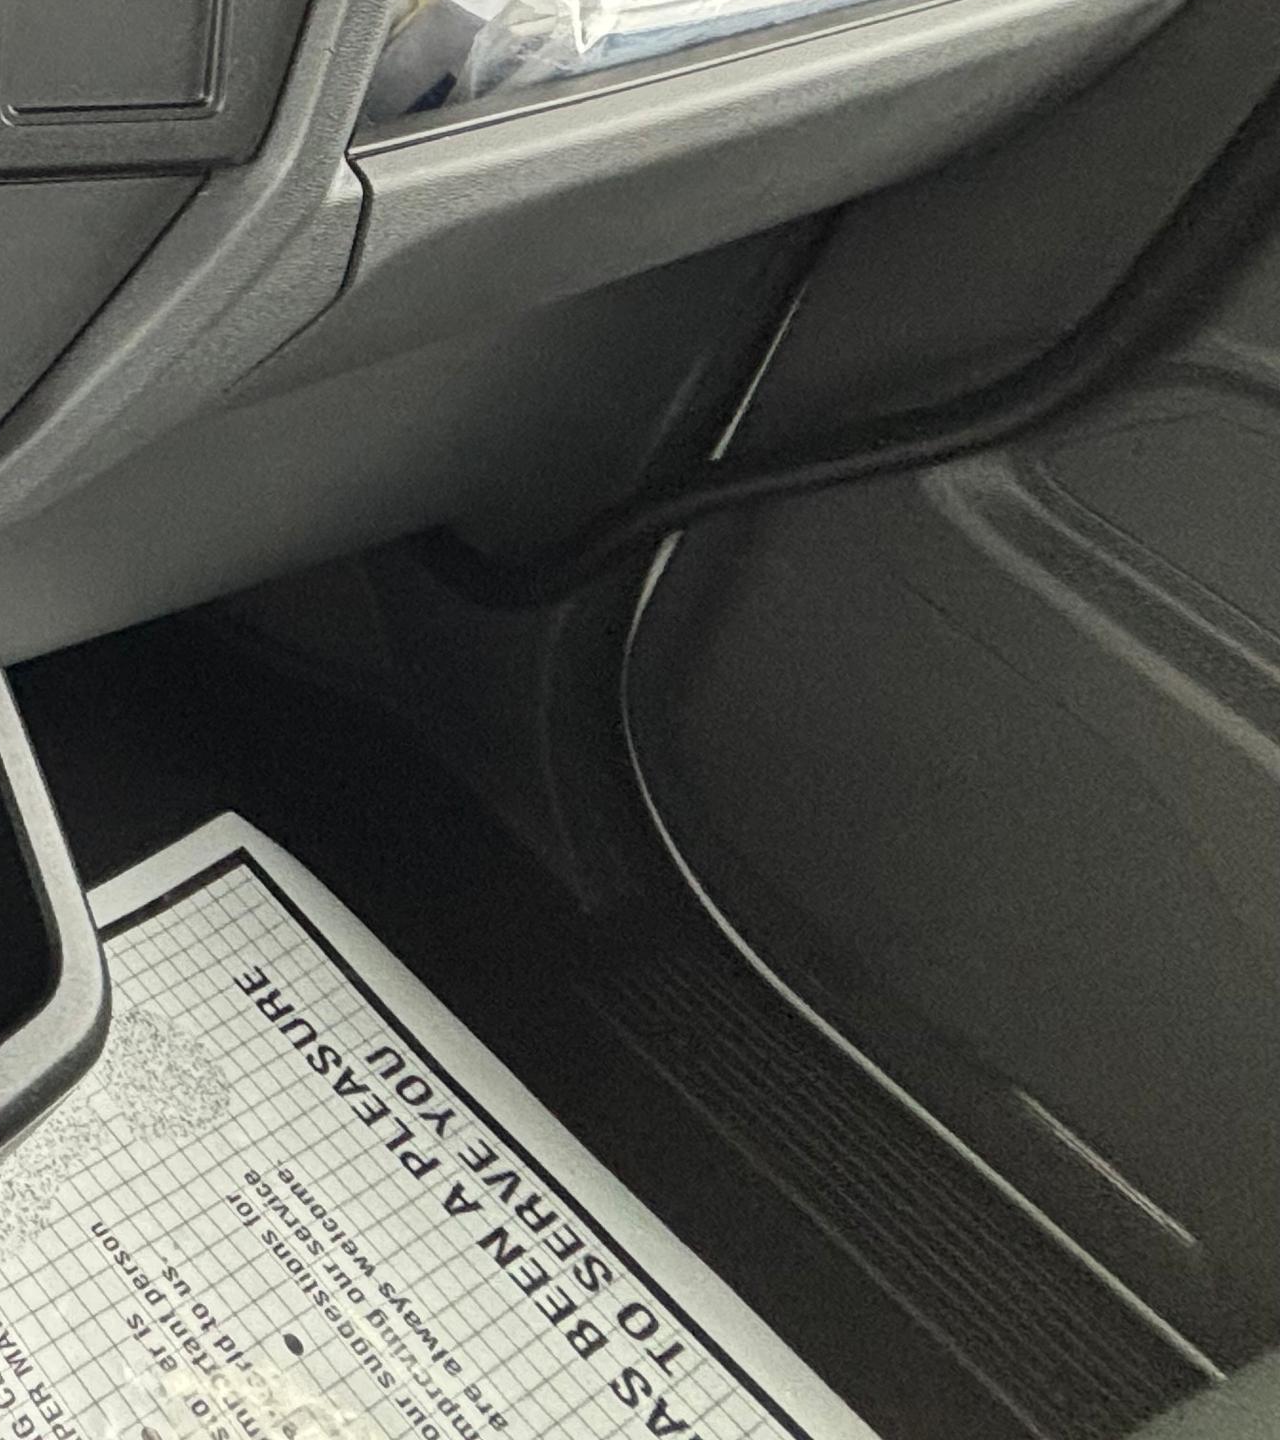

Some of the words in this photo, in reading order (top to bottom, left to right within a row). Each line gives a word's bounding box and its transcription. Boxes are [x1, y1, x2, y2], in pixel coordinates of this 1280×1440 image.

[233, 965, 442, 1181] PLEASURE
[366, 1045, 458, 1139] YOU
[225, 1194, 262, 1228] for
[243, 1168, 325, 1256] service
[277, 1160, 377, 1278] welcome.
[439, 1179, 484, 1218] A
[456, 1137, 617, 1294] SERVE
[91, 1221, 168, 1307] person
[161, 1256, 192, 1298] us.
[323, 1261, 366, 1305] our
[475, 1225, 610, 1360] BEEN
[126, 1313, 152, 1342] is
[191, 1303, 217, 1333] to
[261, 1228, 396, 1389] suggestions
[377, 1281, 463, 1377] always
[616, 1300, 687, 1378] TO
[27, 1382, 84, 1440] PER
[463, 1383, 509, 1433] are
[609, 1366, 704, 1440] AS
